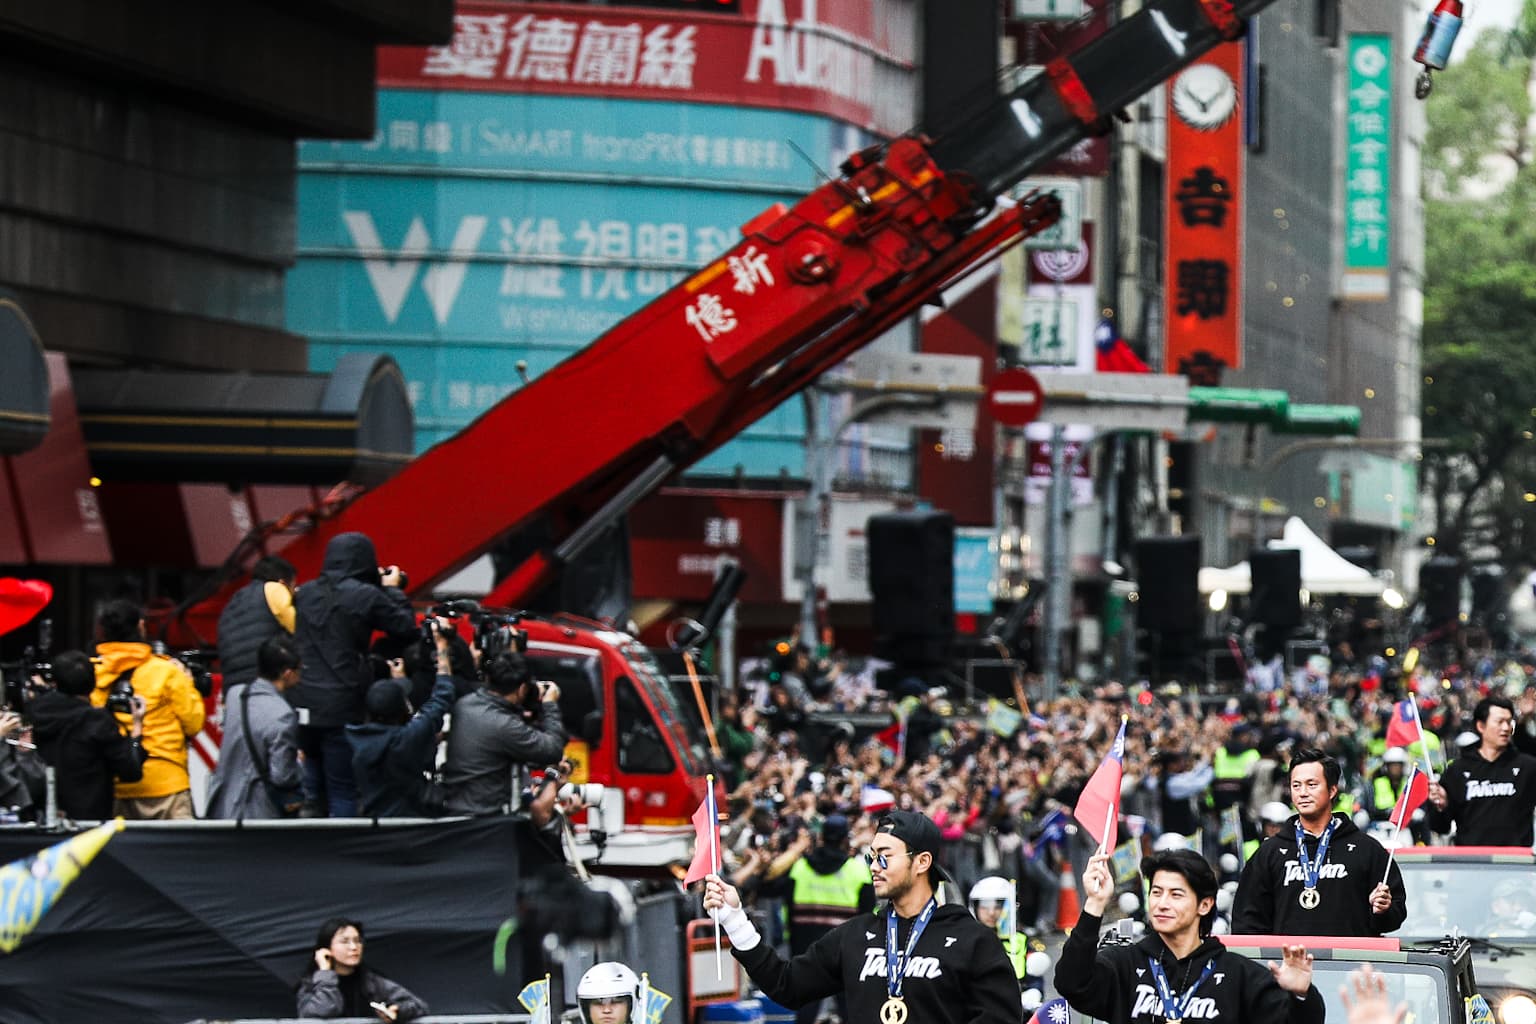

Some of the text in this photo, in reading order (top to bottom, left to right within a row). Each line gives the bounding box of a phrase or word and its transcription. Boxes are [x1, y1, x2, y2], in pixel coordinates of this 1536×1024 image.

[424, 14, 696, 88] 愛德蘭絲
[1283, 860, 1348, 886] Taan
